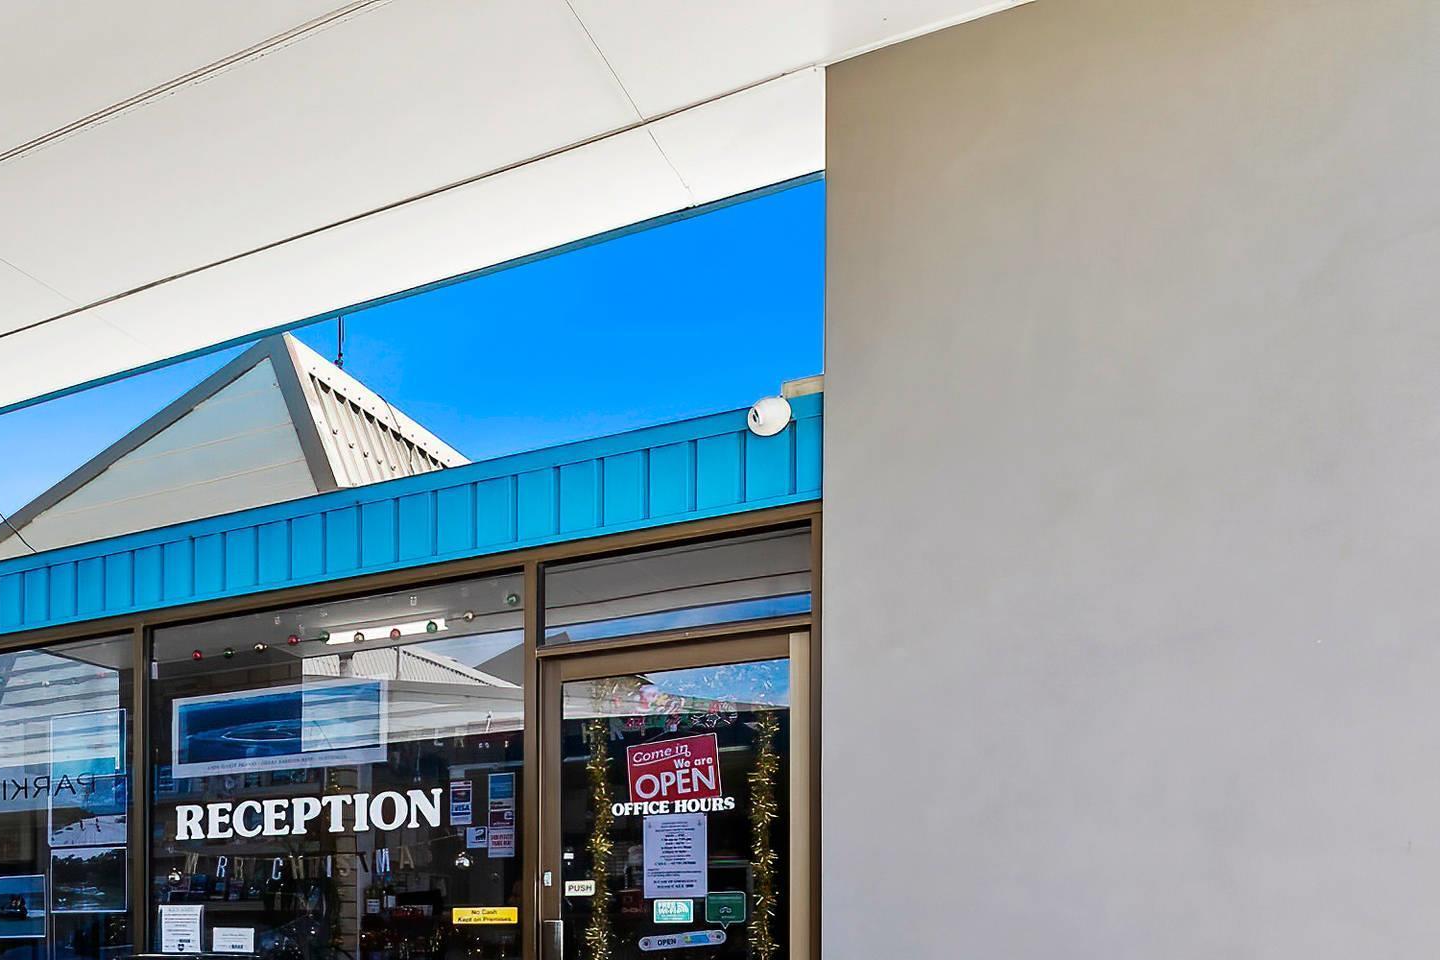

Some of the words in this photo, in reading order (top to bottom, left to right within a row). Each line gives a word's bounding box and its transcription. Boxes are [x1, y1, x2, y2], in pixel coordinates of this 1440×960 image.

[632, 747, 672, 763] Come
[676, 743, 689, 754] in
[673, 759, 691, 769] We
[693, 757, 713, 766] are
[635, 765, 716, 799] OPEN
[175, 788, 443, 841] RECEPTION
[611, 800, 670, 817] OFFICE
[674, 796, 735, 813] HOURS
[568, 884, 592, 892] PUSH
[657, 938, 677, 946] OPEN
